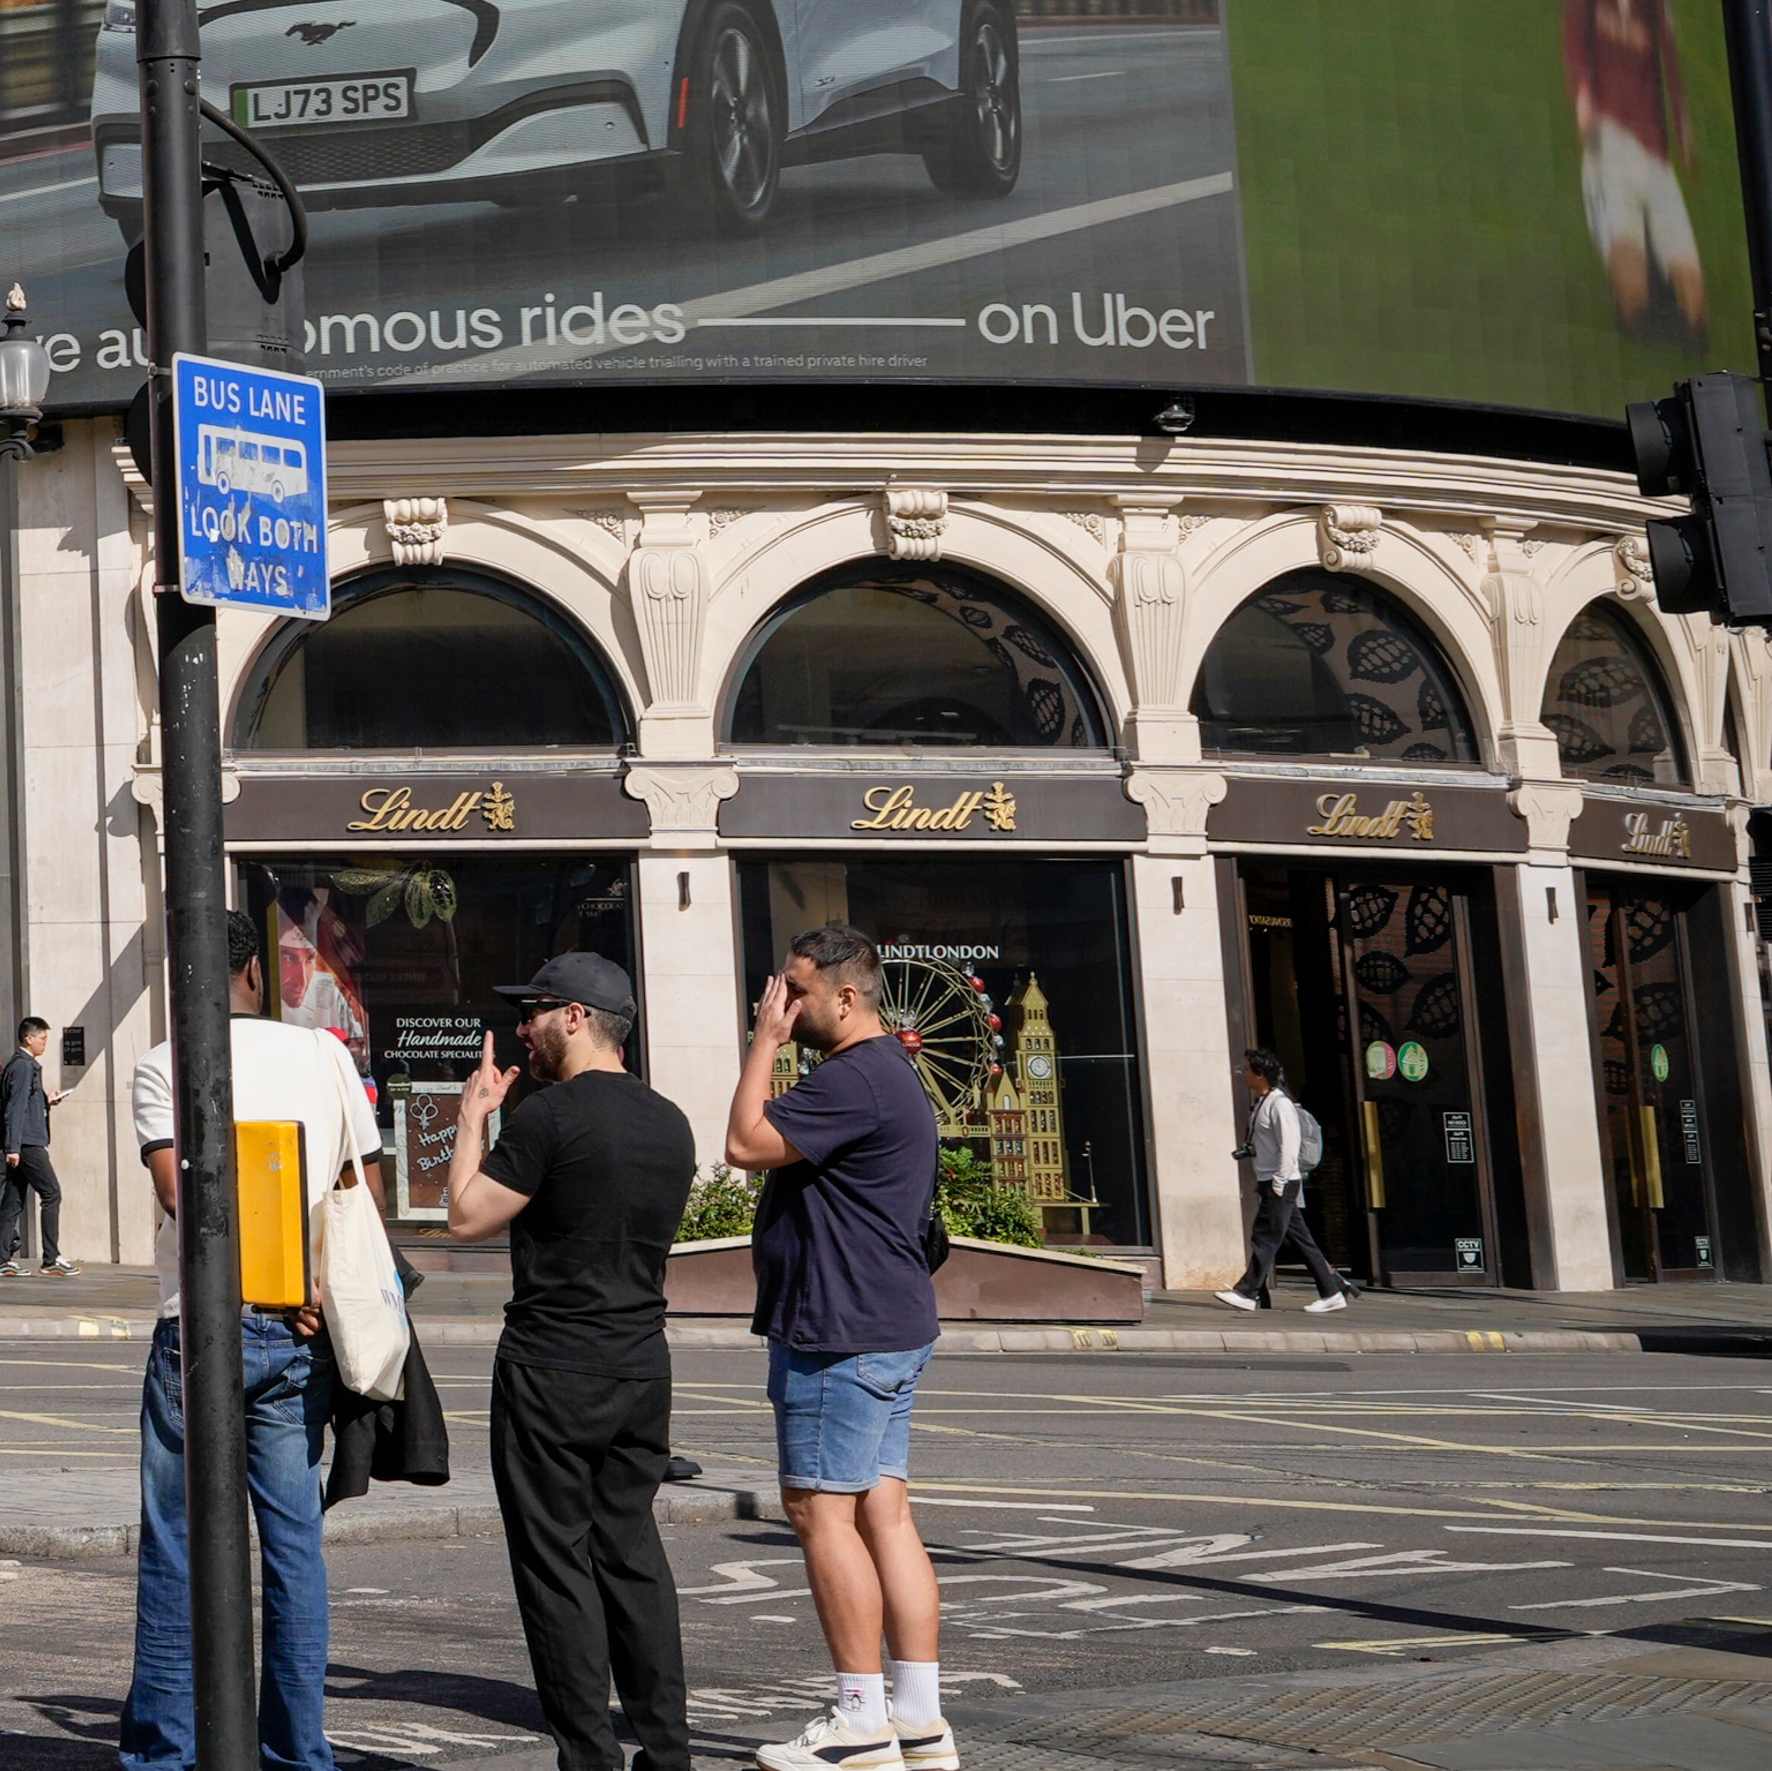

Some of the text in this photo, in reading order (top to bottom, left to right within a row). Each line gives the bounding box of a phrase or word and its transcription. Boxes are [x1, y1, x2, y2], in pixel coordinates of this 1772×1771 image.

[253, 83, 401, 121] LJ73 SPS
[521, 292, 686, 347] rides
[979, 301, 1058, 344] on
[1073, 292, 1215, 349] Uber
[377, 364, 410, 376] code
[414, 362, 428, 375] of
[431, 362, 488, 377] practice
[491, 359, 510, 372] for
[515, 358, 591, 372] automated
[595, 356, 646, 369] vehicle
[649, 355, 702, 370] trialling
[706, 355, 738, 367] with
[742, 358, 751, 367] a
[754, 354, 804, 367] trained
[808, 354, 855, 369] private
[859, 355, 885, 367] hire
[888, 355, 927, 367] driver
[194, 376, 306, 425] BUS LANE
[191, 505, 318, 553] LOOK BOTH
[347, 785, 484, 833] Lindt
[851, 785, 985, 832] Lindt
[1308, 792, 1411, 839] Lindt
[1620, 813, 1676, 857] Lindt
[396, 1018, 481, 1028] DISCOVER OUR
[397, 1030, 482, 1047] Handmade
[384, 1050, 439, 1059] CHOCOLATE
